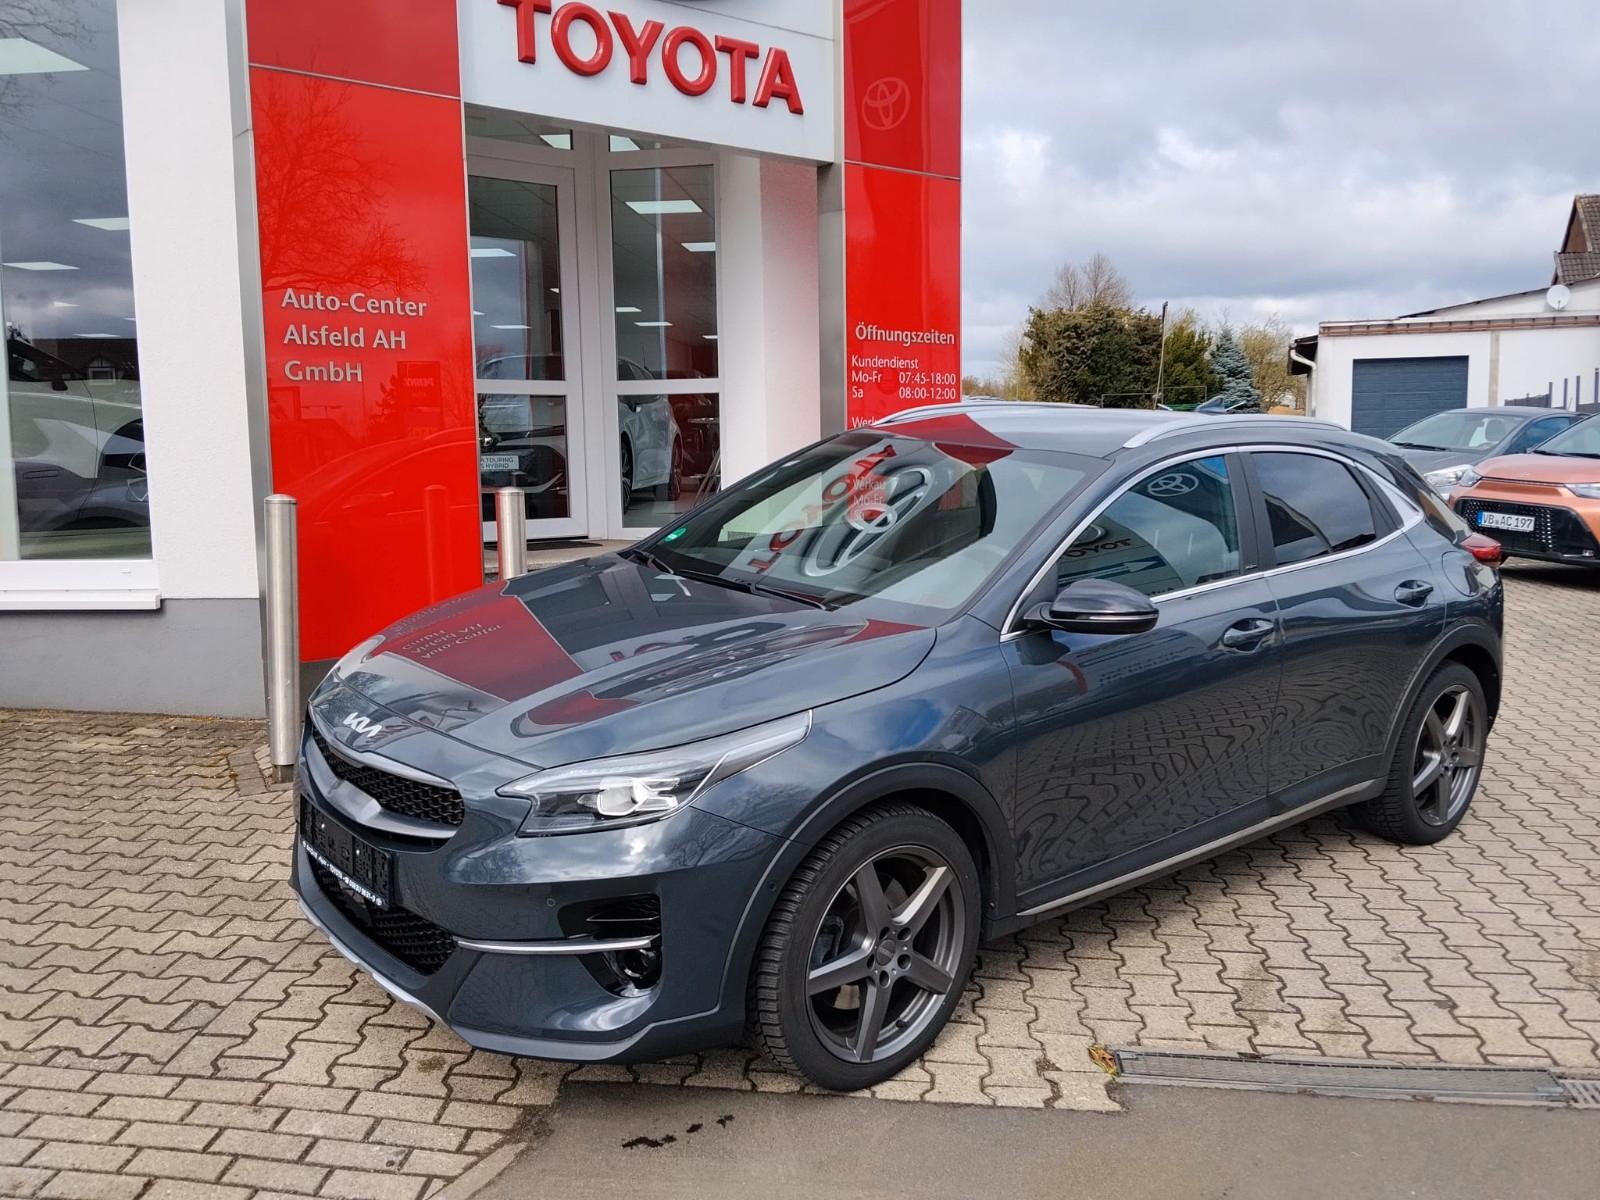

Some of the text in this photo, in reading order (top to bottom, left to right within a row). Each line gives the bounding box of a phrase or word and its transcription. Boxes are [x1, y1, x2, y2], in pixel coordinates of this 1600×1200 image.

[496, 0, 804, 115] TOYOTA
[281, 287, 427, 317] Auto-Center
[283, 323, 407, 350] Alsfeld AH
[855, 321, 955, 347] Öffnungszeiten
[284, 359, 363, 383] GmbH
[851, 354, 919, 369] Kundendienst
[851, 370, 956, 385] Mo-Fr 07:45-18:00
[852, 385, 956, 400] Sa 08:00-12:00
[853, 477, 886, 490] Verkau
[1483, 513, 1533, 529] VB AC 197
[343, 711, 383, 738] KIA
